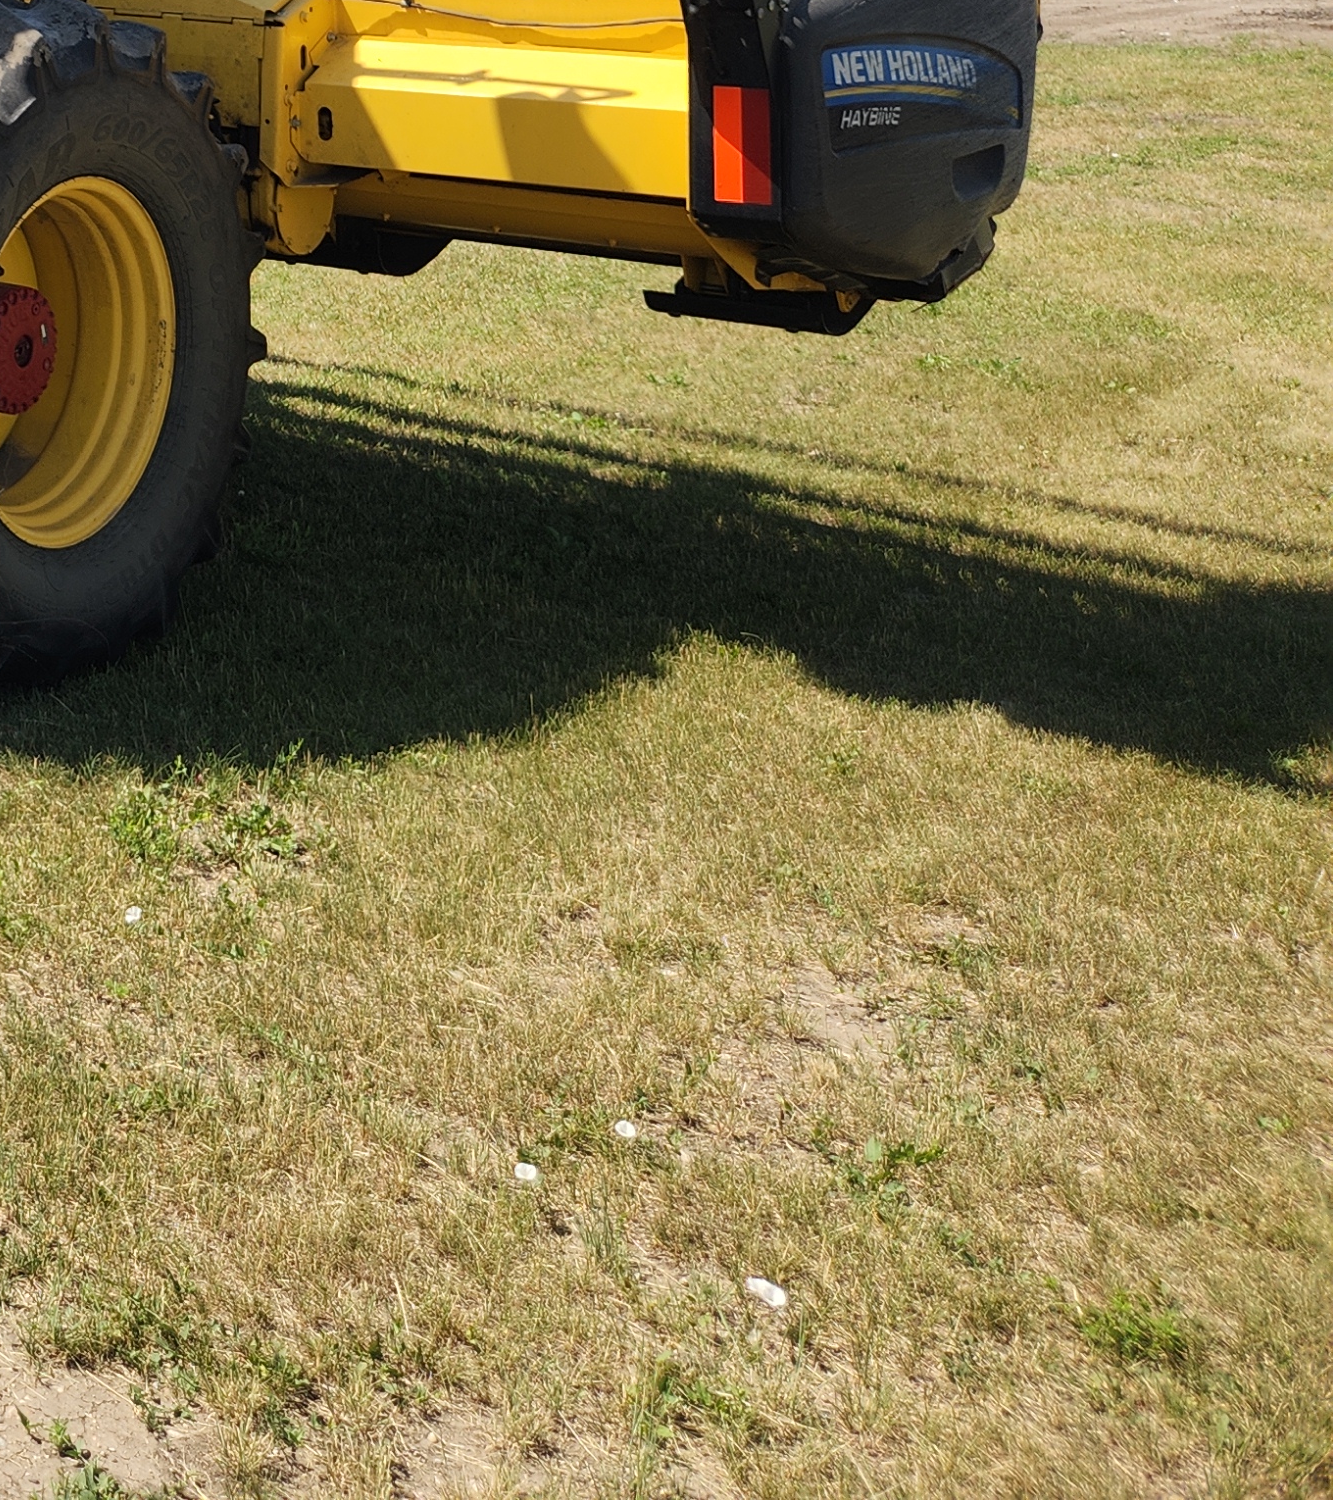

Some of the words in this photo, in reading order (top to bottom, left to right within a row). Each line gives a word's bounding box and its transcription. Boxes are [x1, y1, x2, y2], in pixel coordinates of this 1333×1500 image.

[832, 49, 883, 86] NEW
[885, 50, 977, 89] HOLLAND
[840, 106, 902, 130] HAYBINE
